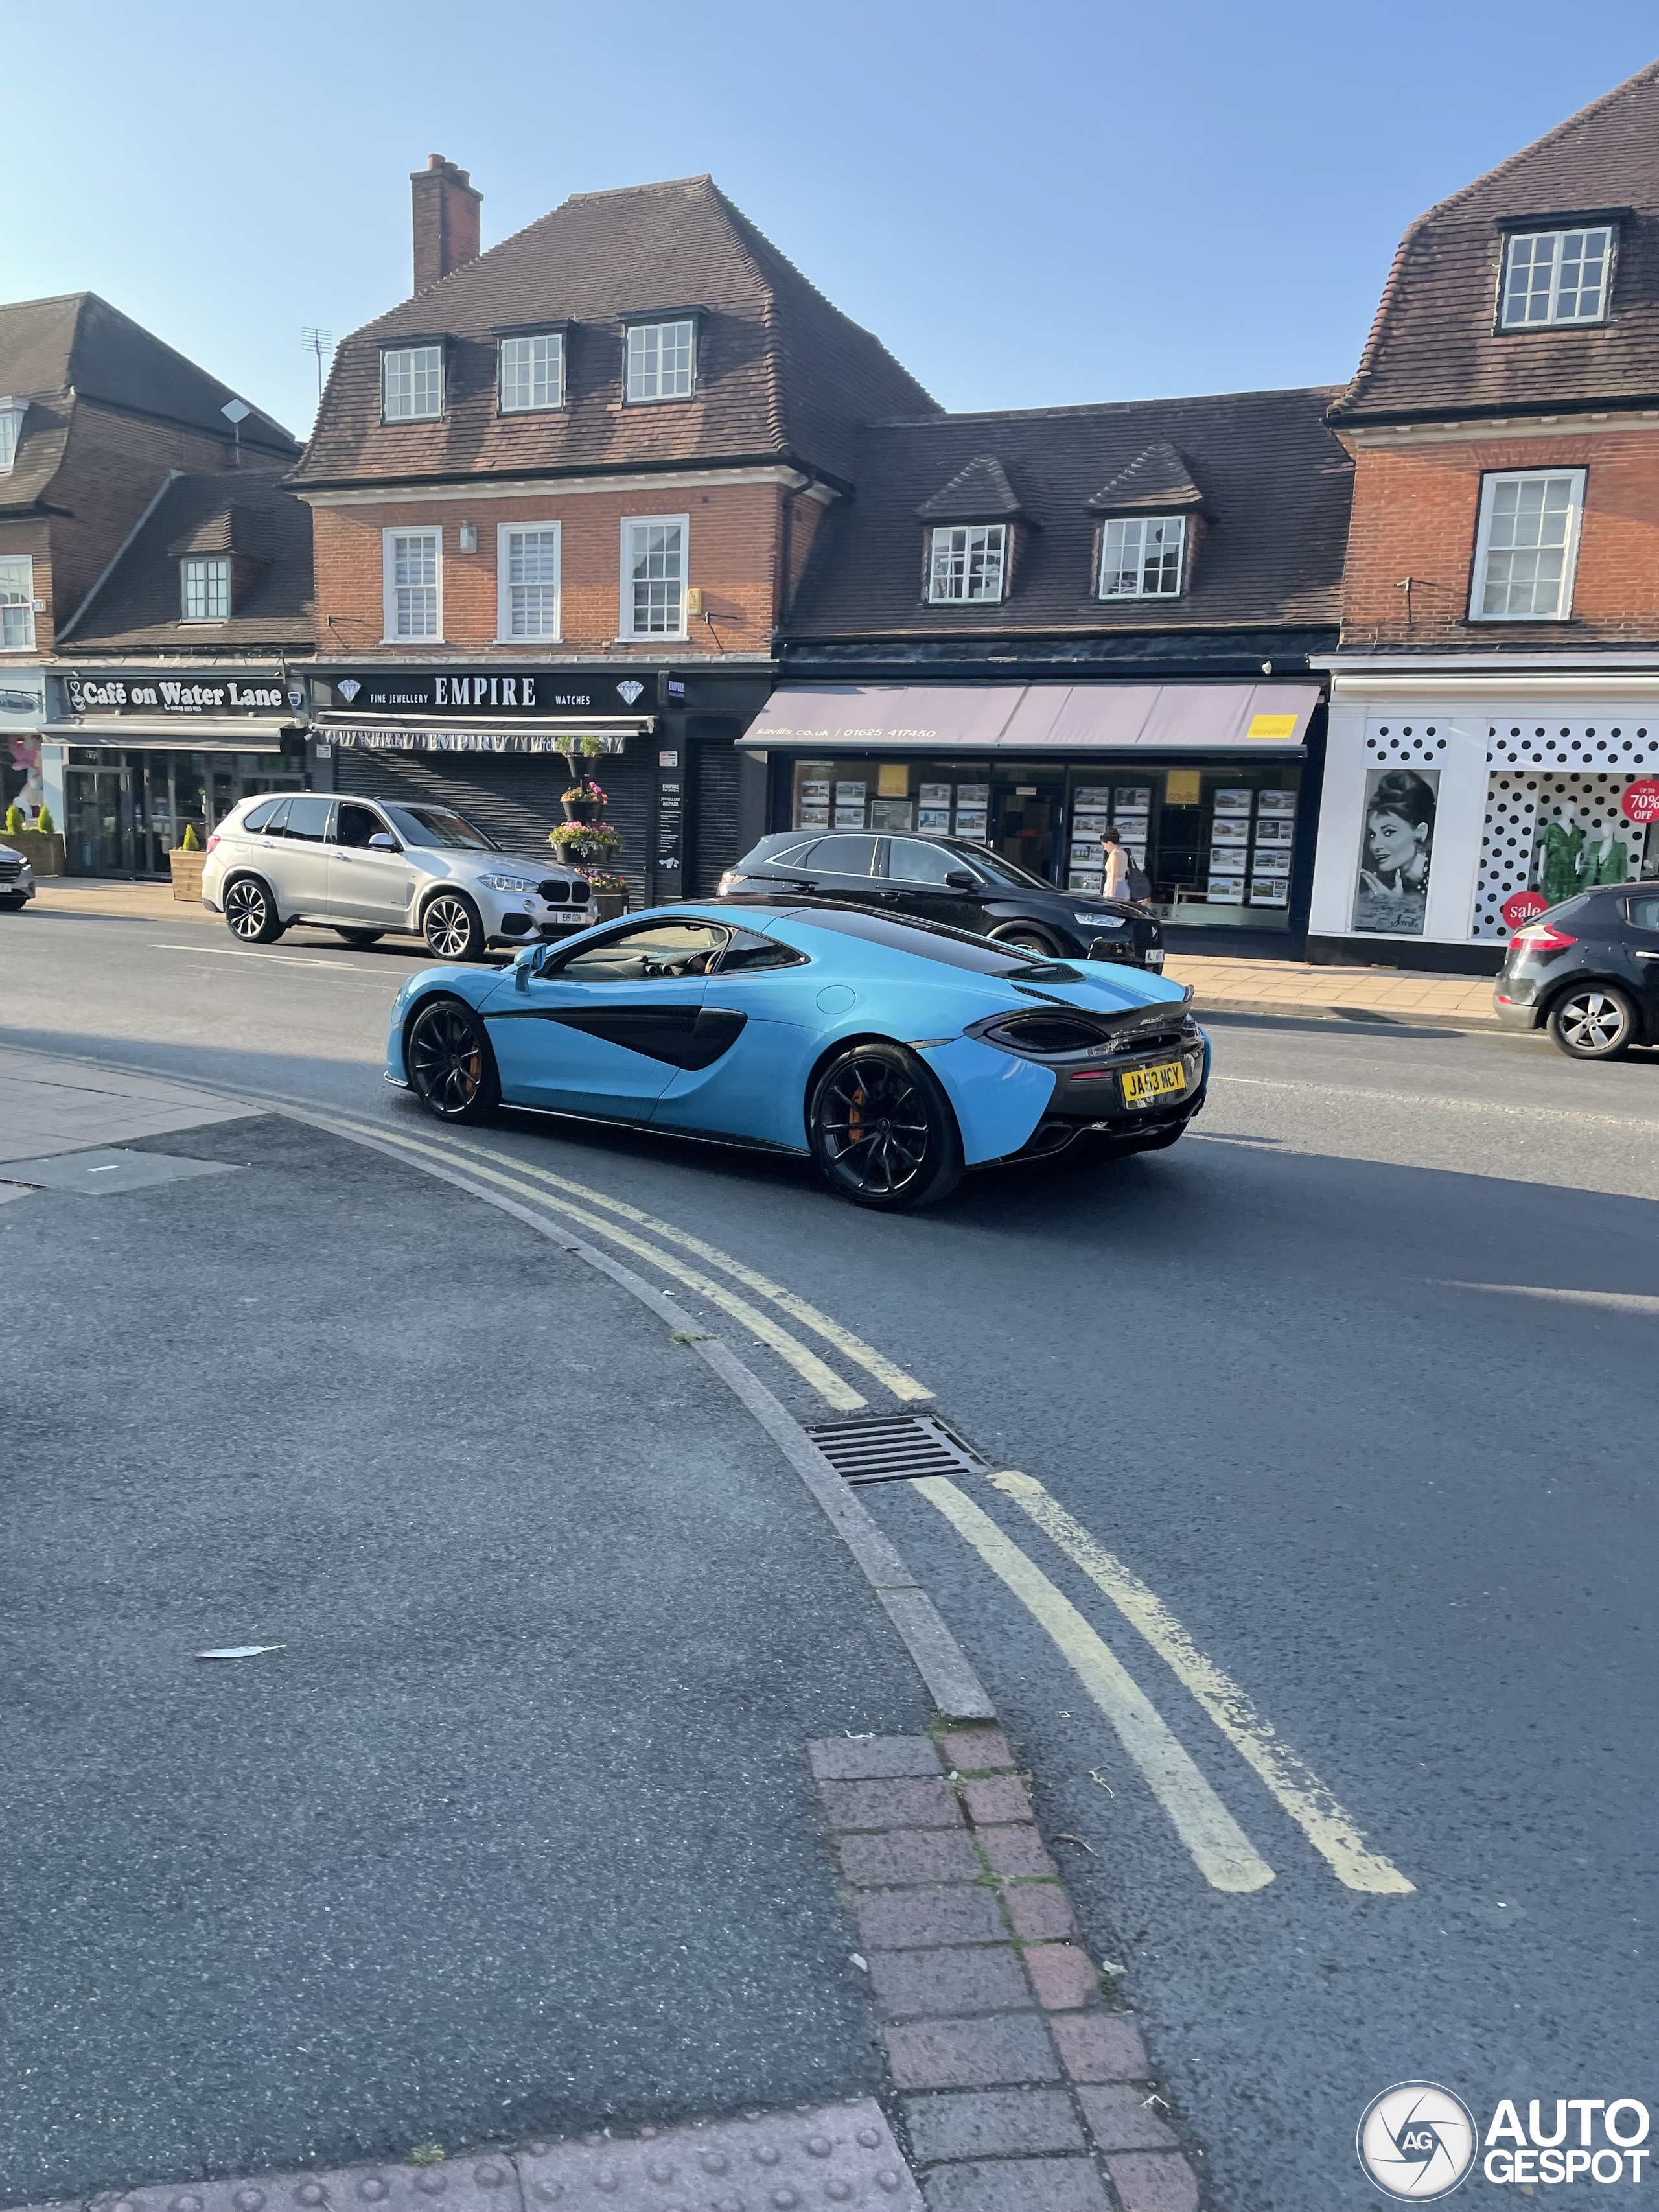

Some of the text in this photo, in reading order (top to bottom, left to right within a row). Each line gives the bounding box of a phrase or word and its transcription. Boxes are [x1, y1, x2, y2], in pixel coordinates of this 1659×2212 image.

[82, 682, 282, 706] Café on Water Lane
[370, 693, 428, 704] FINE JEWELLERY
[434, 677, 536, 706] EMPIRE
[555, 695, 590, 706] WATCHES
[756, 727, 830, 737] savills.co.uk
[843, 728, 883, 737] 01625
[887, 729, 936, 738] 417450
[426, 734, 504, 752] EMPIRE
[1630, 794, 1659, 809] 70%
[1633, 809, 1653, 820] OFF
[1509, 902, 1541, 918] sale
[1160, 1066, 1179, 1089] MCY
